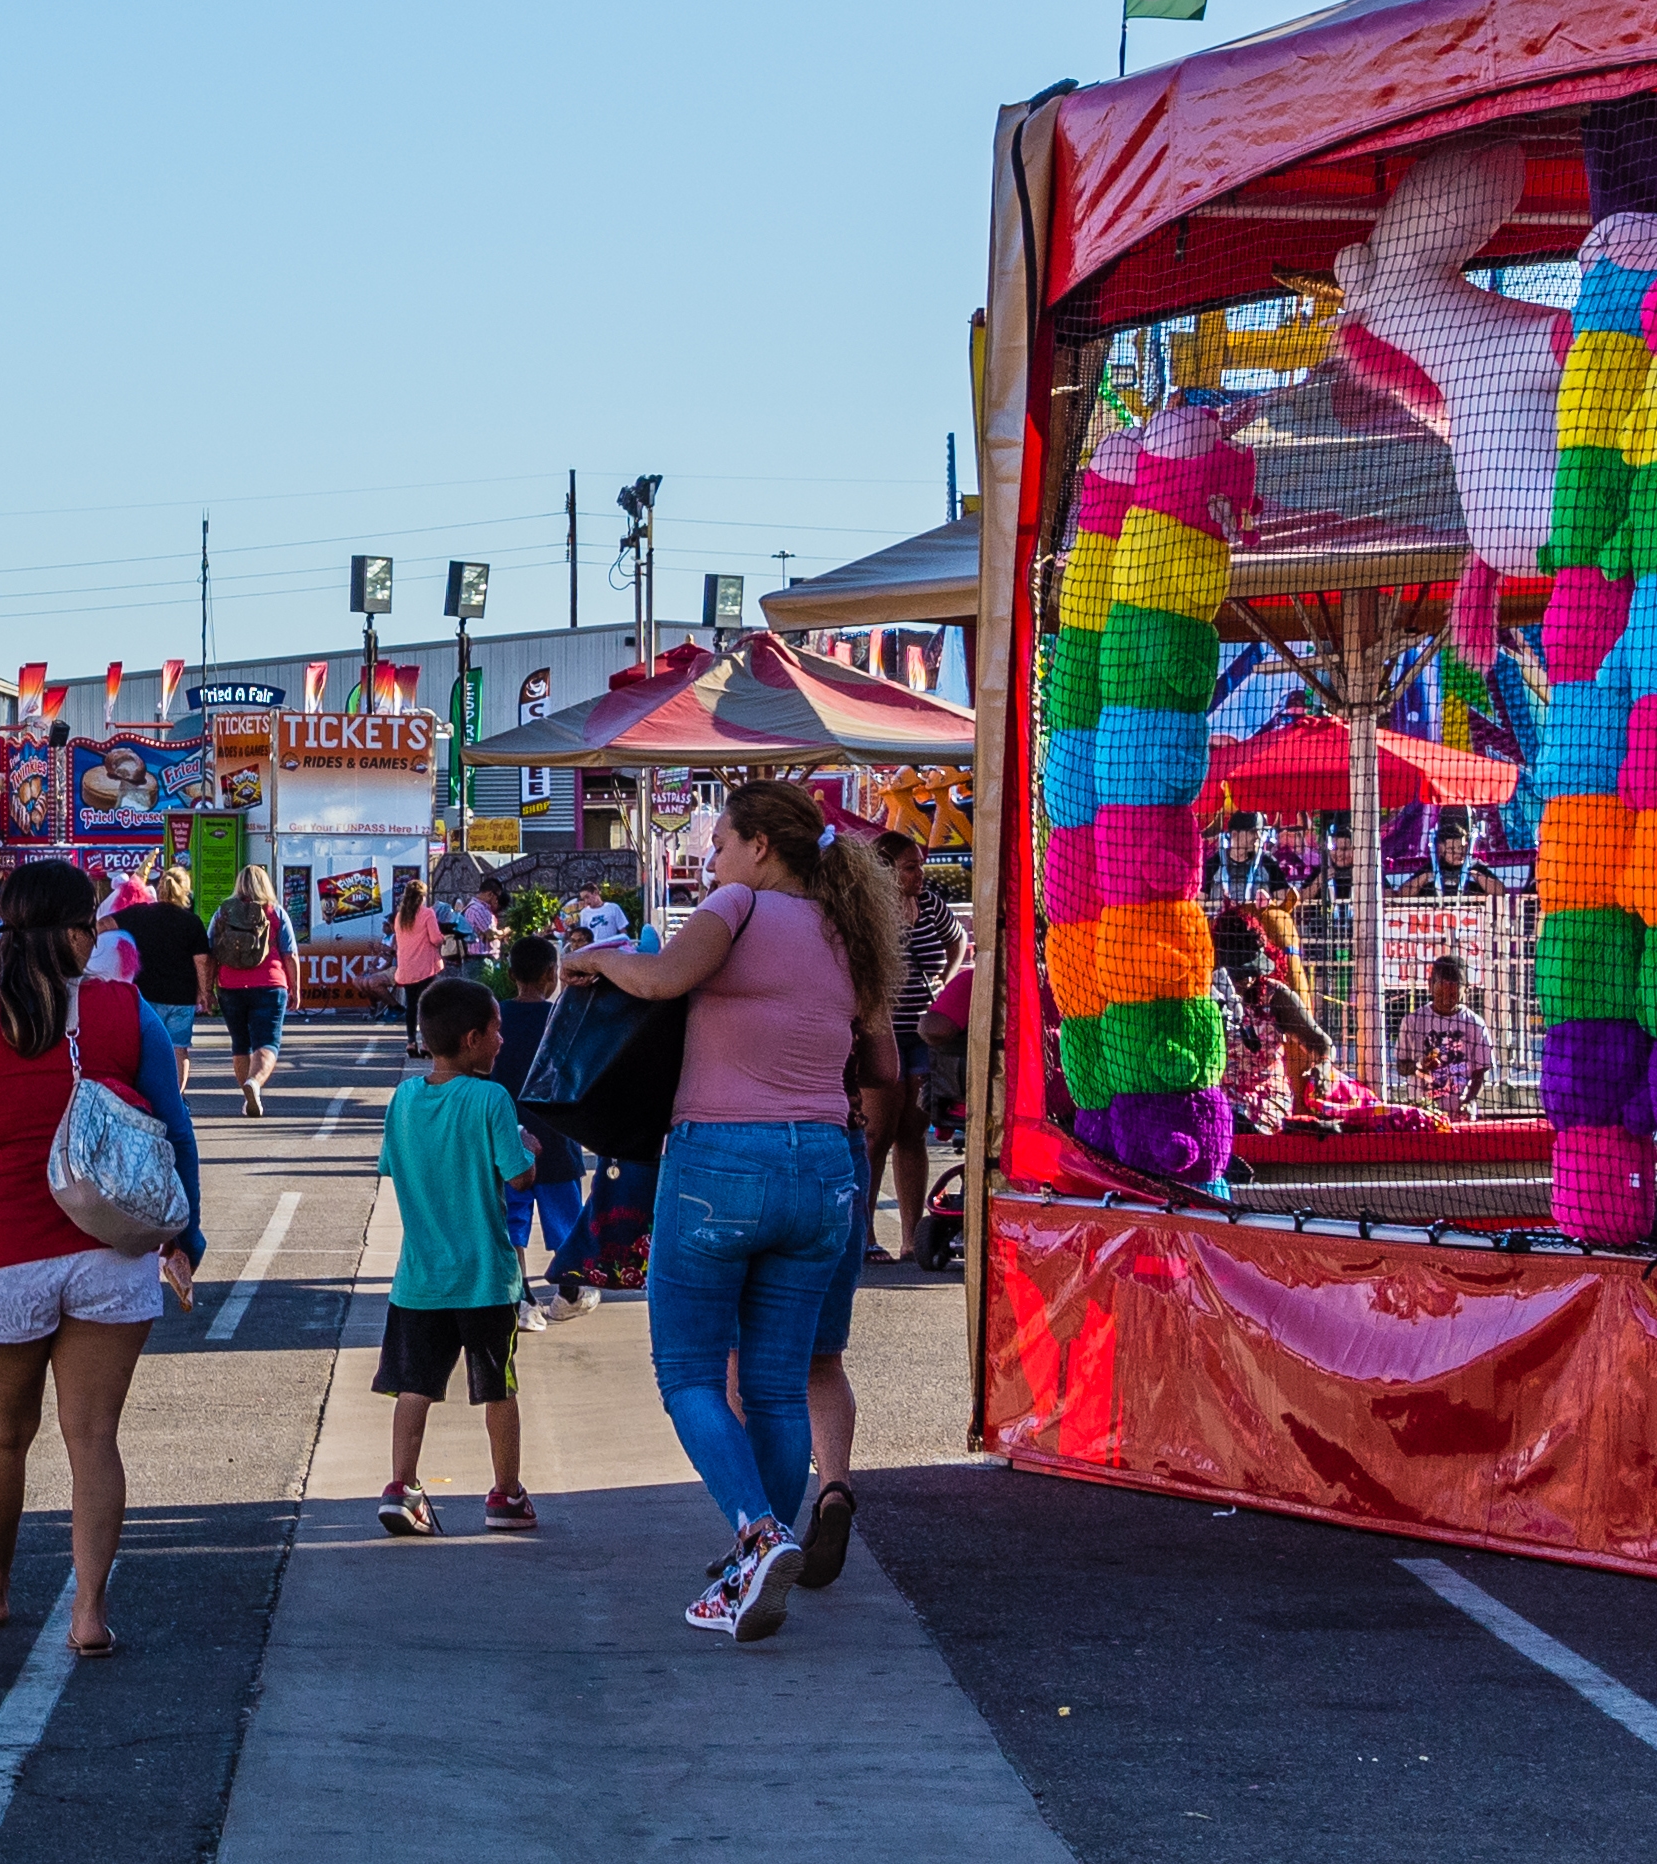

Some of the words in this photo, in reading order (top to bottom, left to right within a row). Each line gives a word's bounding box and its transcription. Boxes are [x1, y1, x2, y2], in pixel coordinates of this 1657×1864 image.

[235, 687, 246, 701] A
[248, 687, 274, 704] Fair
[216, 715, 270, 735] TICKETS
[283, 715, 428, 750] TICKETS
[217, 744, 237, 758] RIDES
[245, 744, 269, 757] GAMES
[303, 755, 343, 769] RIDES
[346, 756, 356, 768] &
[359, 756, 408, 771] GAMES
[163, 760, 201, 783] Fried
[651, 792, 691, 804] FASTPASS
[522, 800, 551, 816] SHOP
[658, 804, 684, 815] LANE
[81, 807, 114, 829] Fried
[288, 822, 306, 833] Get
[310, 823, 333, 833] Your
[336, 823, 386, 833] FUNPASS
[389, 824, 413, 834] Here
[104, 854, 152, 868] PECA
[1408, 912, 1457, 934] NO
